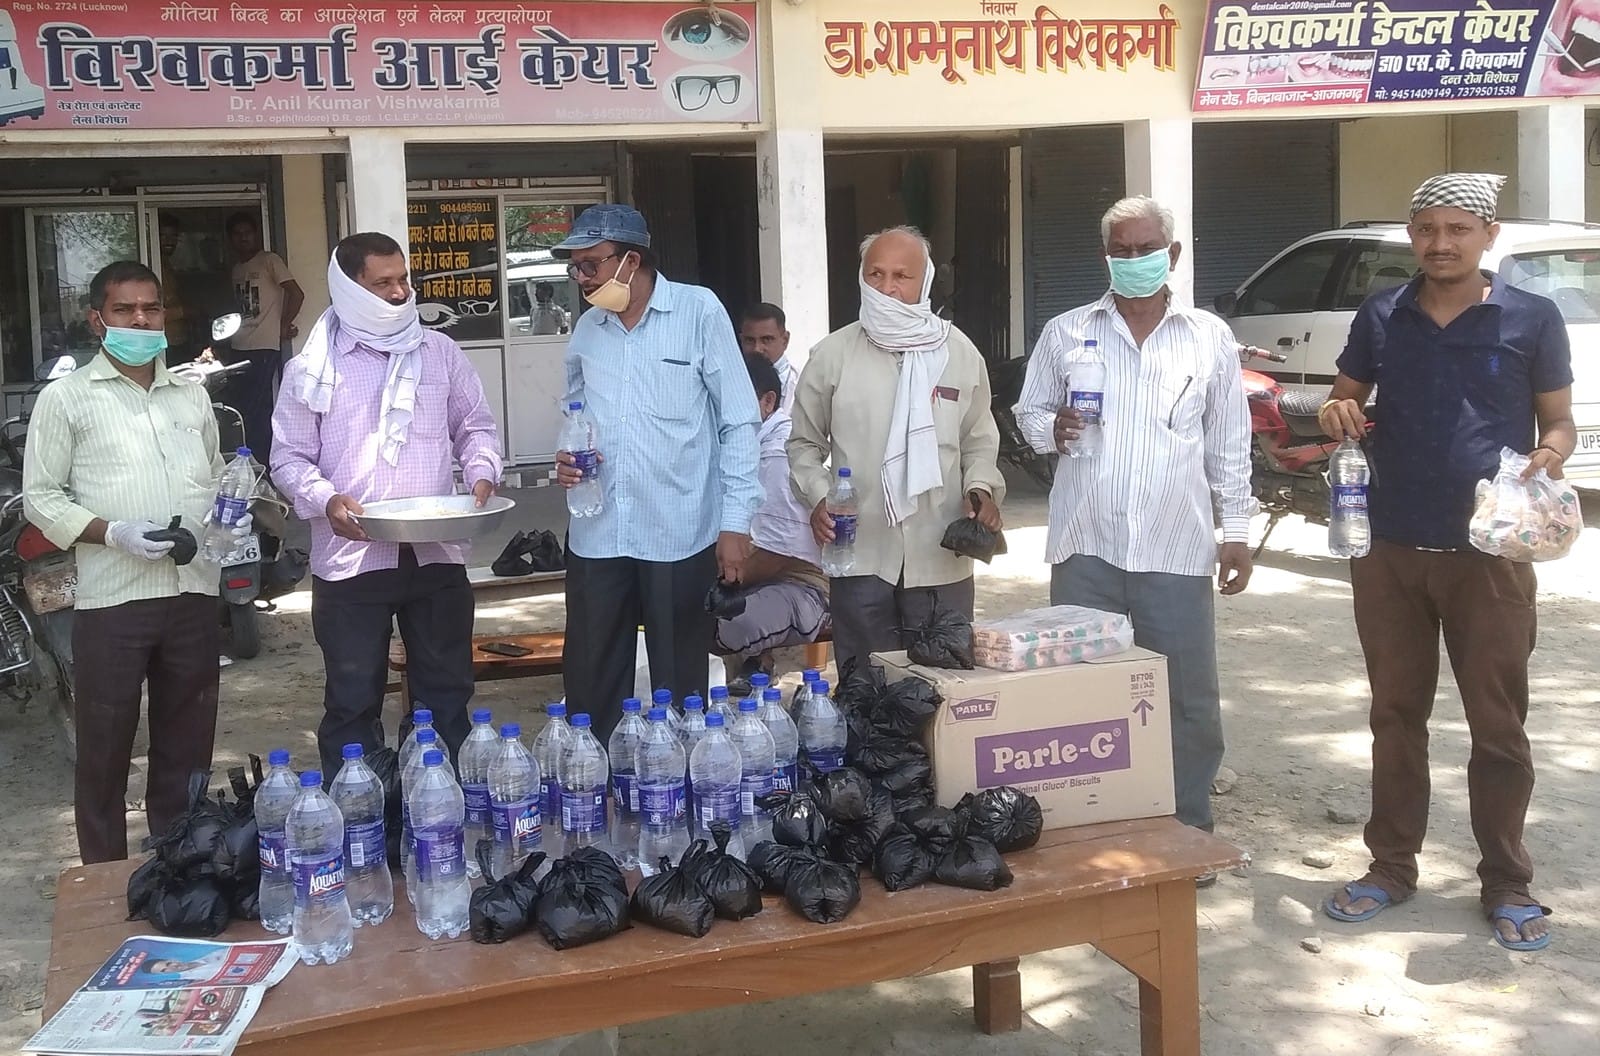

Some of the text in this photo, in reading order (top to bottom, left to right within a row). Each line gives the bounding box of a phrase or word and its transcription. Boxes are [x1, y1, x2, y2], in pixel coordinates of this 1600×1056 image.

[13, 2, 128, 12] Reg. No. 2724 (Lucknow)
[160, 2, 552, 26] मोतिया बिन्द का आपरेशन एवं लेन्स प्रत्यारोपण
[980, 0, 1017, 16] निवास
[1214, 1, 1539, 51] विश्वकर्मा डेन्टल केयर
[1032, 3, 1181, 72] विश्वकर्मा
[37, 22, 660, 95] विश्वकर्मा आई केयर
[1459, 47, 1527, 70] विश्वकर्मा
[1440, 71, 1519, 85] दन्त रोग विशेषज्ञ
[1200, 92, 1220, 106] मेन
[1457, 85, 1516, 97] 7379501538
[230, 94, 500, 110] Dr. Anil Kumar Vishwakarma
[480, 223, 495, 241] तक
[454, 251, 470, 269] तक
[477, 279, 492, 297] तक
[955, 702, 993, 715] PARLE
[1069, 775, 1101, 788] Biscuits
